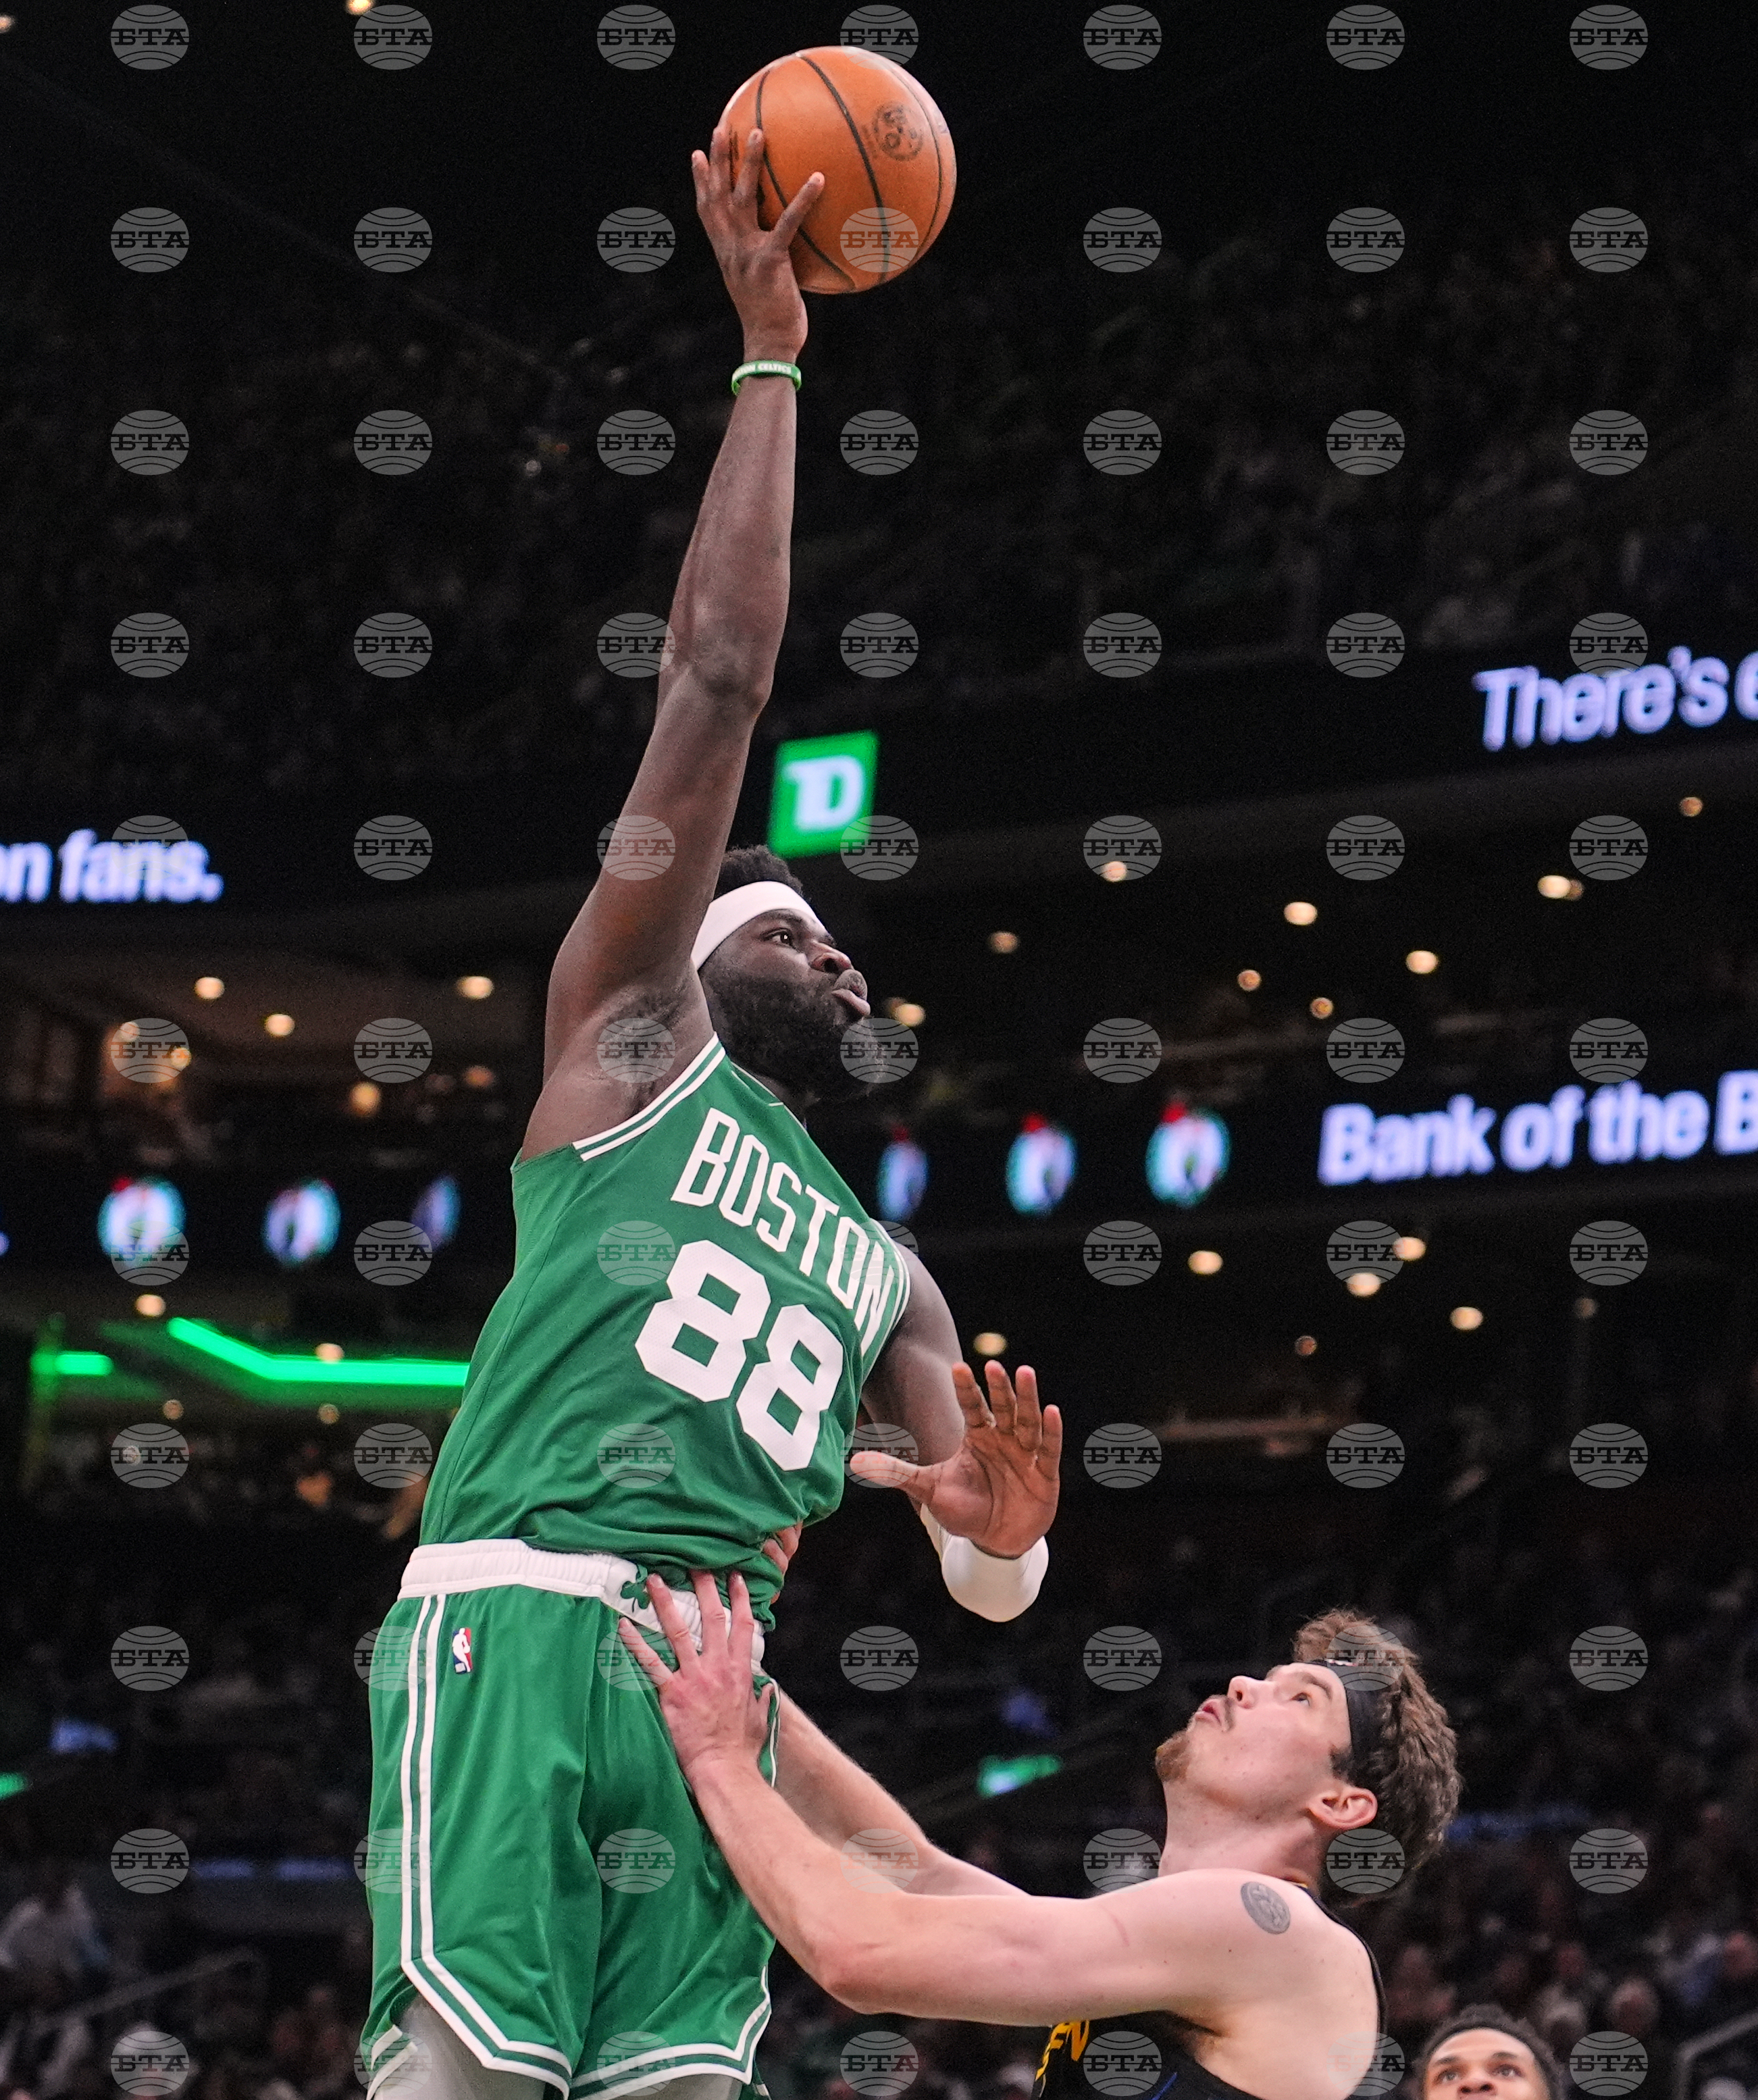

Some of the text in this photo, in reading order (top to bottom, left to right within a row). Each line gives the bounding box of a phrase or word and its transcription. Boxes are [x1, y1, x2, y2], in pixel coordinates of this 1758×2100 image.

[1472, 646, 1729, 752] There's
[783, 754, 864, 831] TD
[58, 828, 224, 903] fans.
[1317, 1094, 1497, 1186] Bank
[1499, 1084, 1586, 1172] of
[1588, 1080, 1710, 1164] the
[671, 1108, 895, 1356] BOSTON
[635, 1239, 844, 1471] 88
